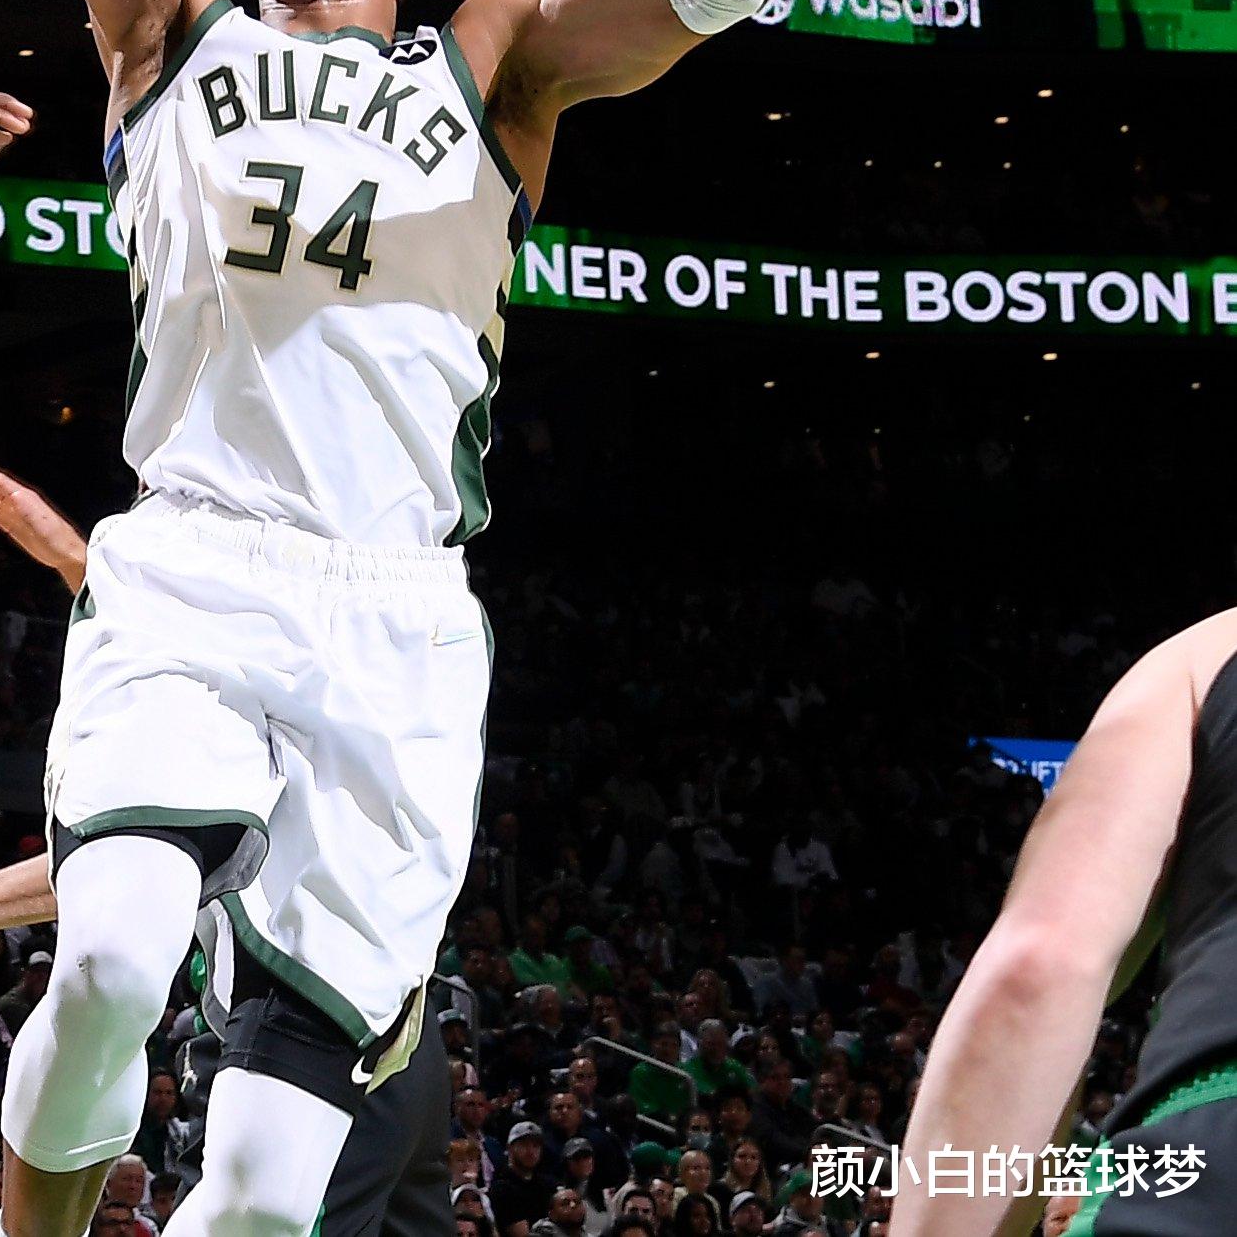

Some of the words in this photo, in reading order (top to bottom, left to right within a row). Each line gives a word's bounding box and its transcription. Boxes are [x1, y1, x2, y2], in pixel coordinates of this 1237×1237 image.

[194, 50, 468, 177] BUCKS
[223, 158, 379, 292] 34
[524, 241, 648, 303] NER
[665, 254, 748, 311] OF
[761, 262, 883, 322] THE
[905, 270, 1190, 324] BOSTON
